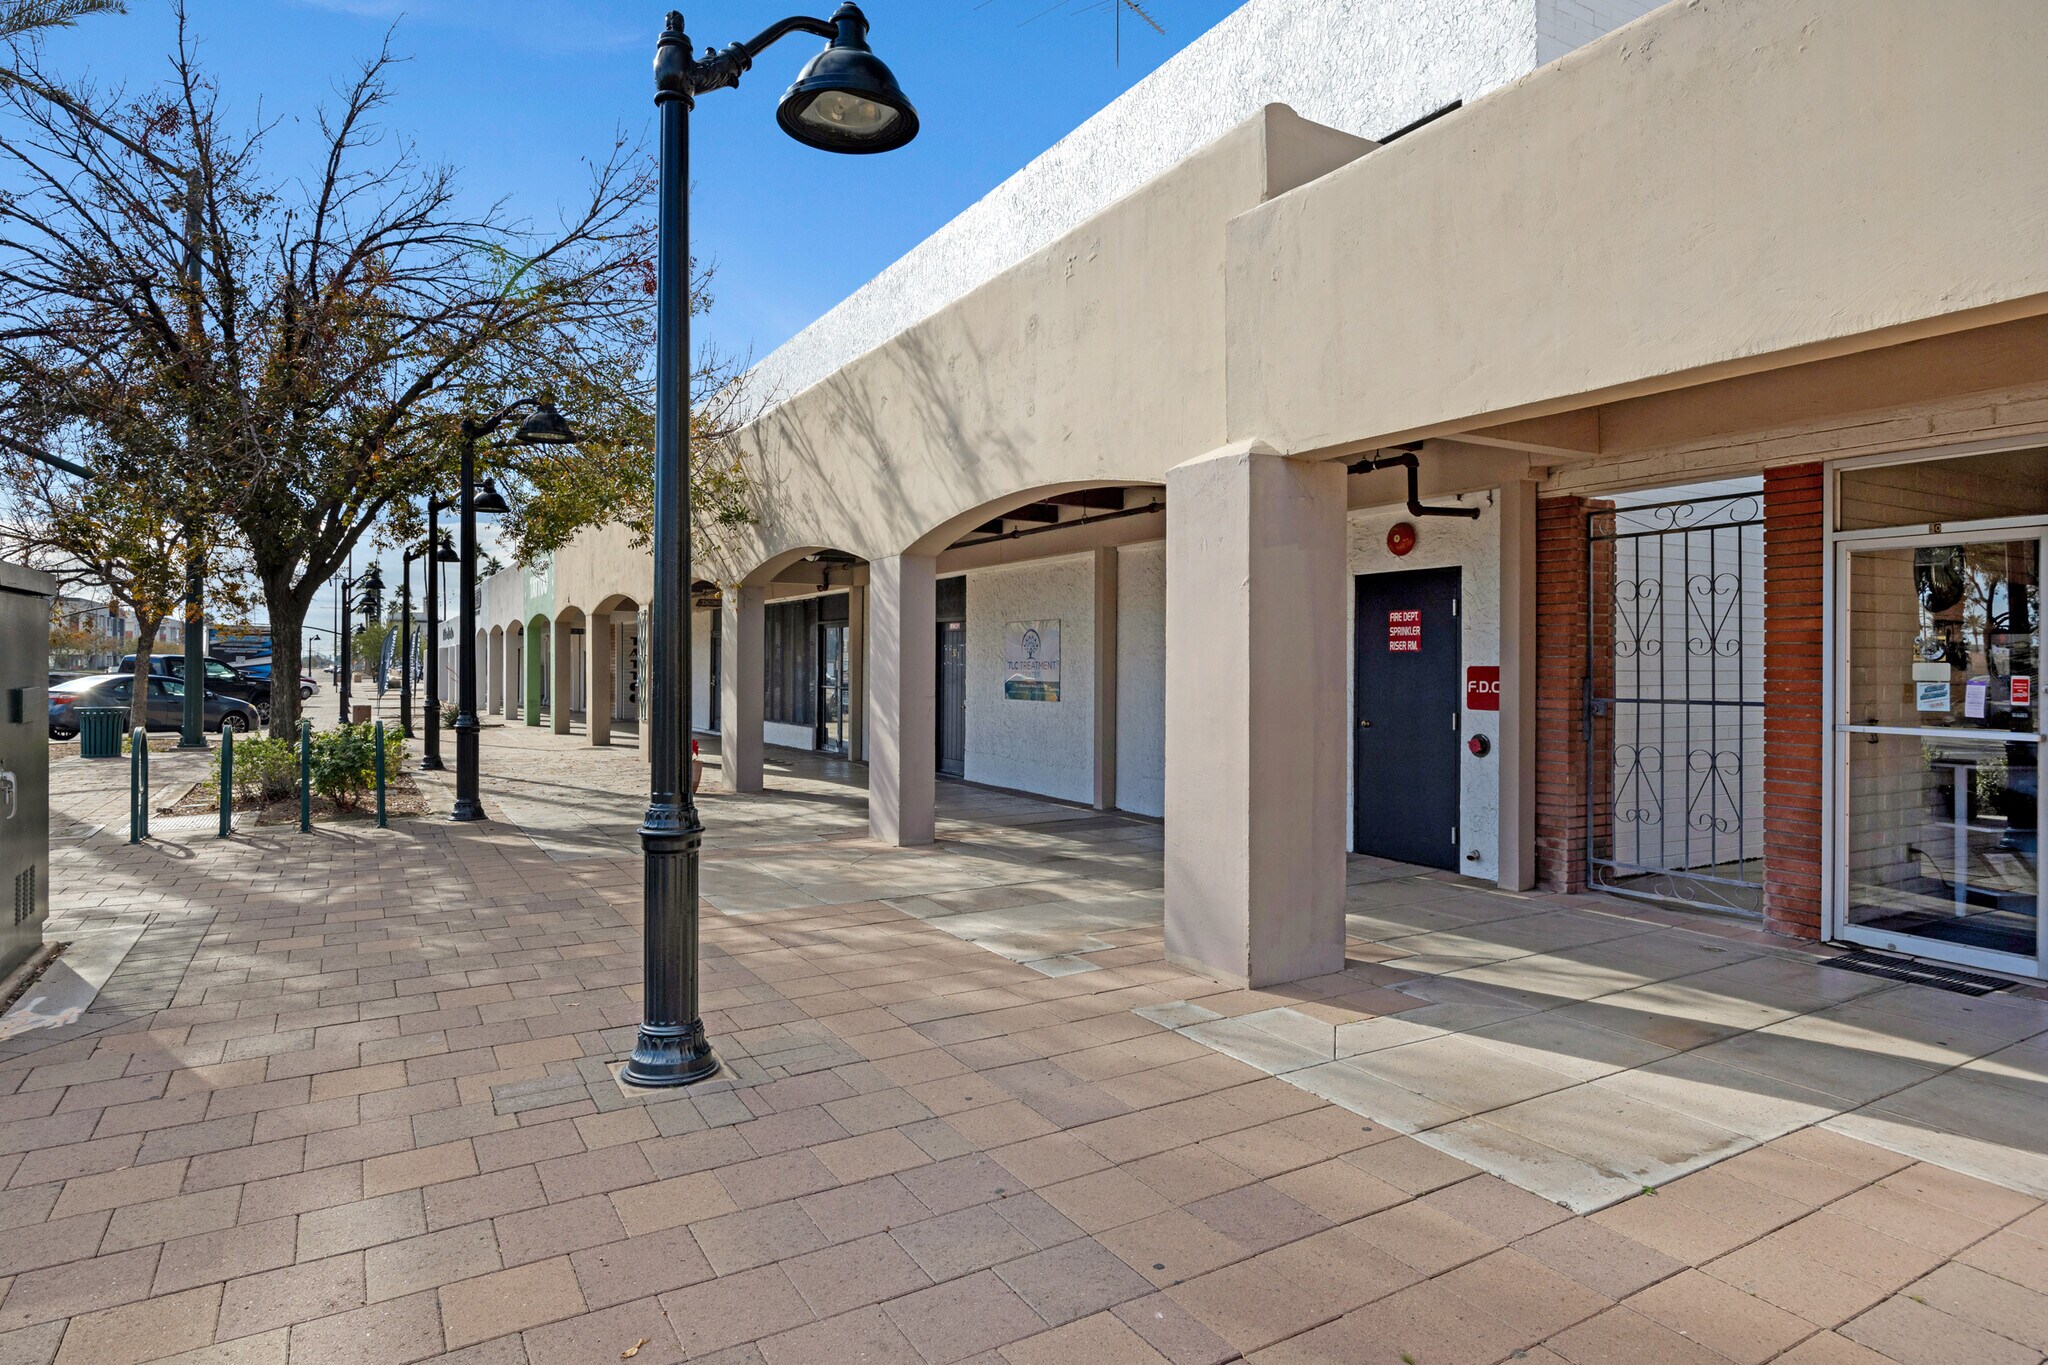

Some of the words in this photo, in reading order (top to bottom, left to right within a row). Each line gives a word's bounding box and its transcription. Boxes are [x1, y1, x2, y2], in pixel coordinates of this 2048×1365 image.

[1390, 612, 1402, 622] FIRE
[1390, 626, 1420, 636] SPRINKLER
[1390, 641, 1407, 650] RISER
[1008, 661, 1019, 670] TLC
[1020, 661, 1056, 670] TREATMENT
